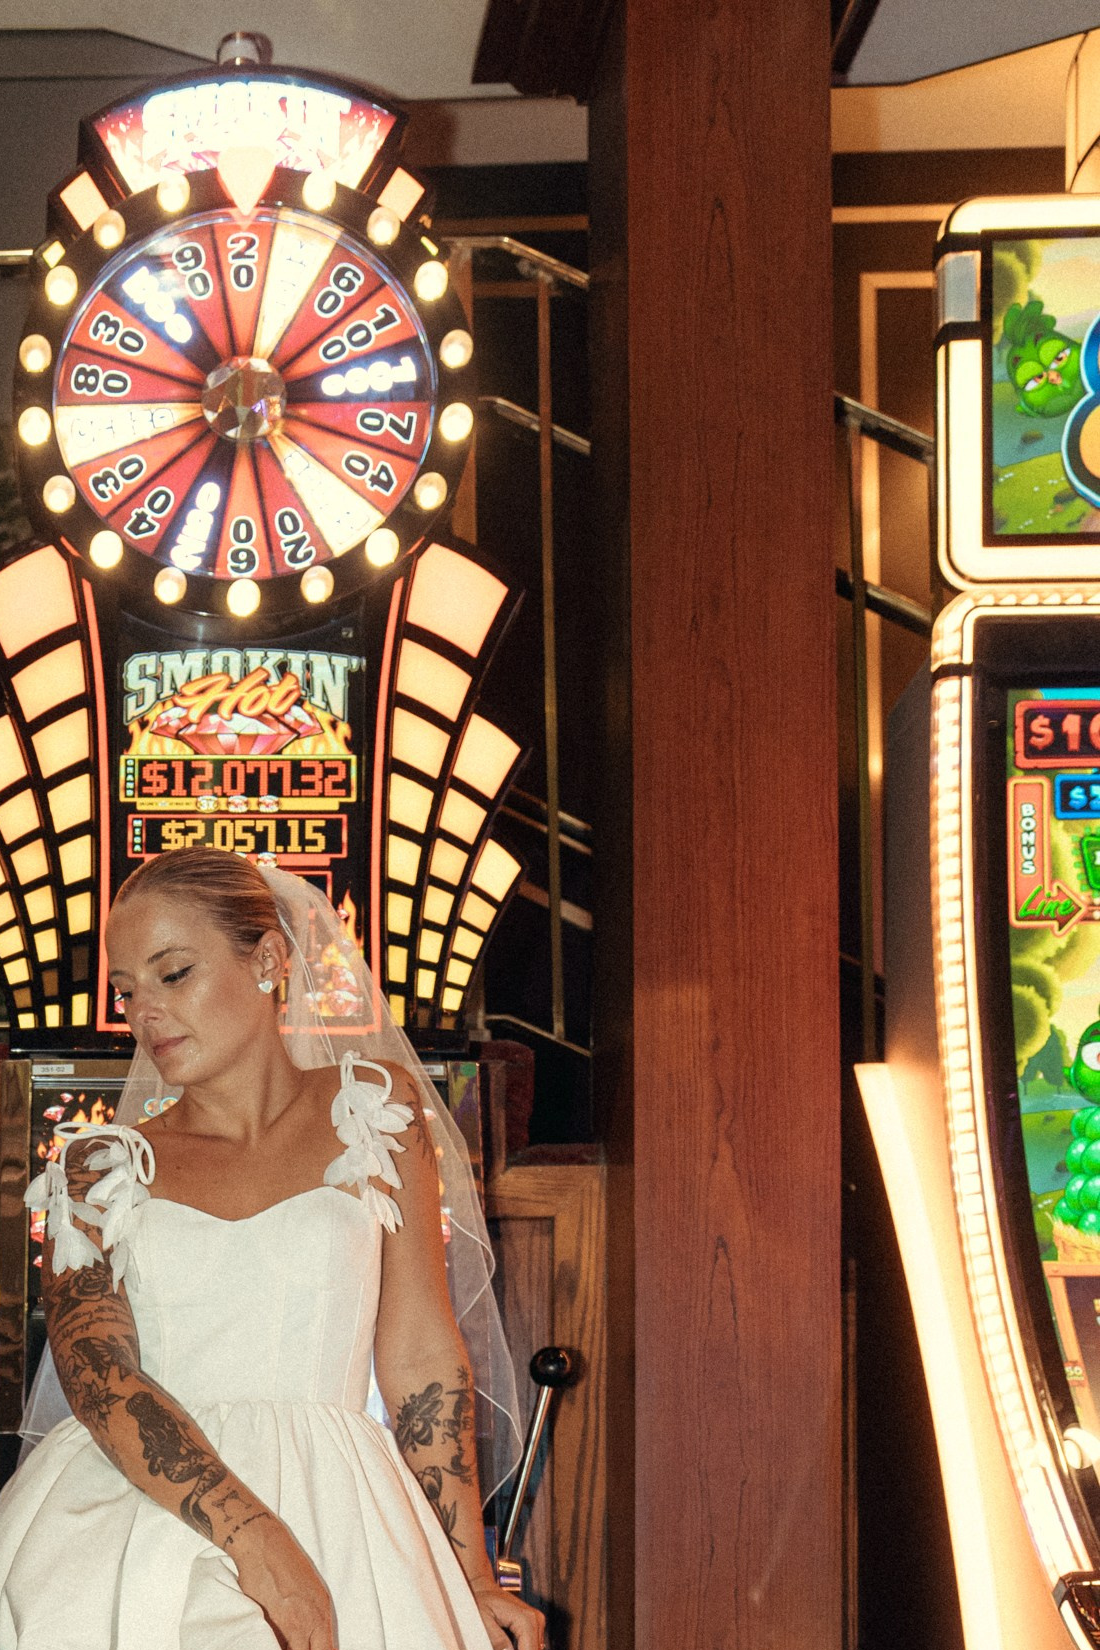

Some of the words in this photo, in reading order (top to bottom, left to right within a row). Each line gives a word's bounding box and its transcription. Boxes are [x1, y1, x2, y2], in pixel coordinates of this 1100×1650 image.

[172, 241, 211, 300] 90
[227, 233, 258, 291] 20
[314, 262, 364, 318] 60
[89, 311, 146, 356] 30
[318, 304, 401, 363] 100
[69, 362, 131, 397] 80
[357, 408, 417, 444] 70
[89, 455, 146, 501] 30
[340, 450, 398, 496] 40
[123, 486, 174, 541] 40
[274, 508, 316, 568] 20
[173, 667, 301, 724] Hot
[142, 760, 346, 796] $12,077.32
[1020, 802, 1038, 876] BONUS
[1018, 885, 1076, 918] Line
